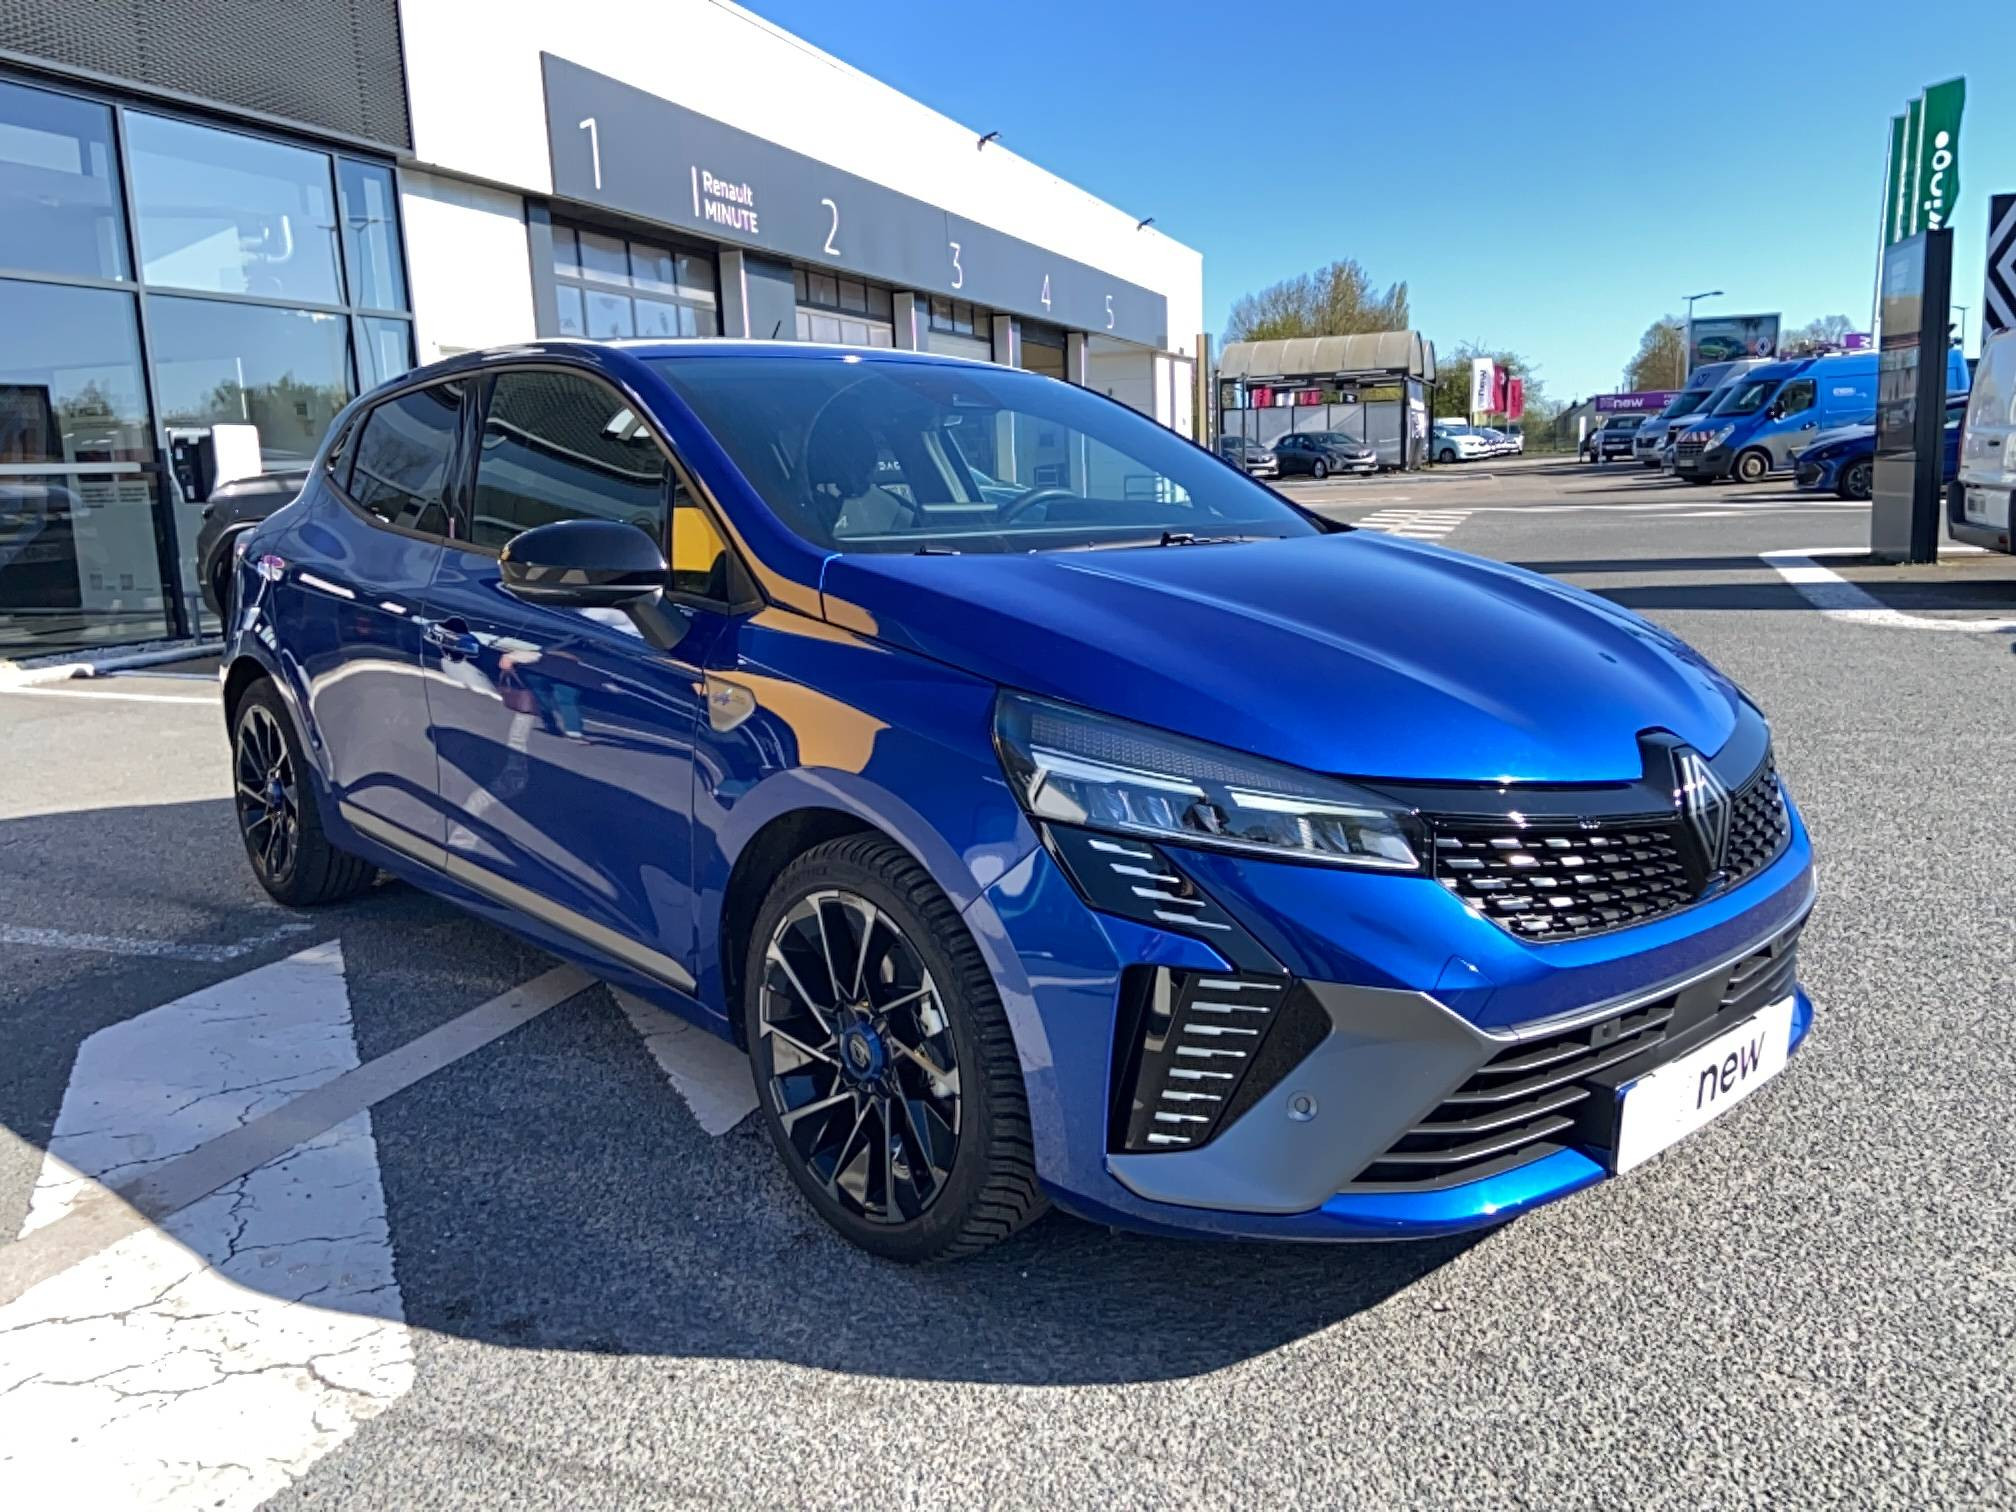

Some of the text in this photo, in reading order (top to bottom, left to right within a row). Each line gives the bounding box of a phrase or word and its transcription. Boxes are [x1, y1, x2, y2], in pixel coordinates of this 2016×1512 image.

[579, 117, 601, 190] 1
[702, 170, 754, 207] Renault
[704, 199, 760, 234] MINUTE
[821, 198, 841, 257] 2
[949, 242, 963, 289] 3
[1040, 273, 1051, 312] 4
[1105, 295, 1115, 329] 5
[1696, 1031, 1766, 1110] new
